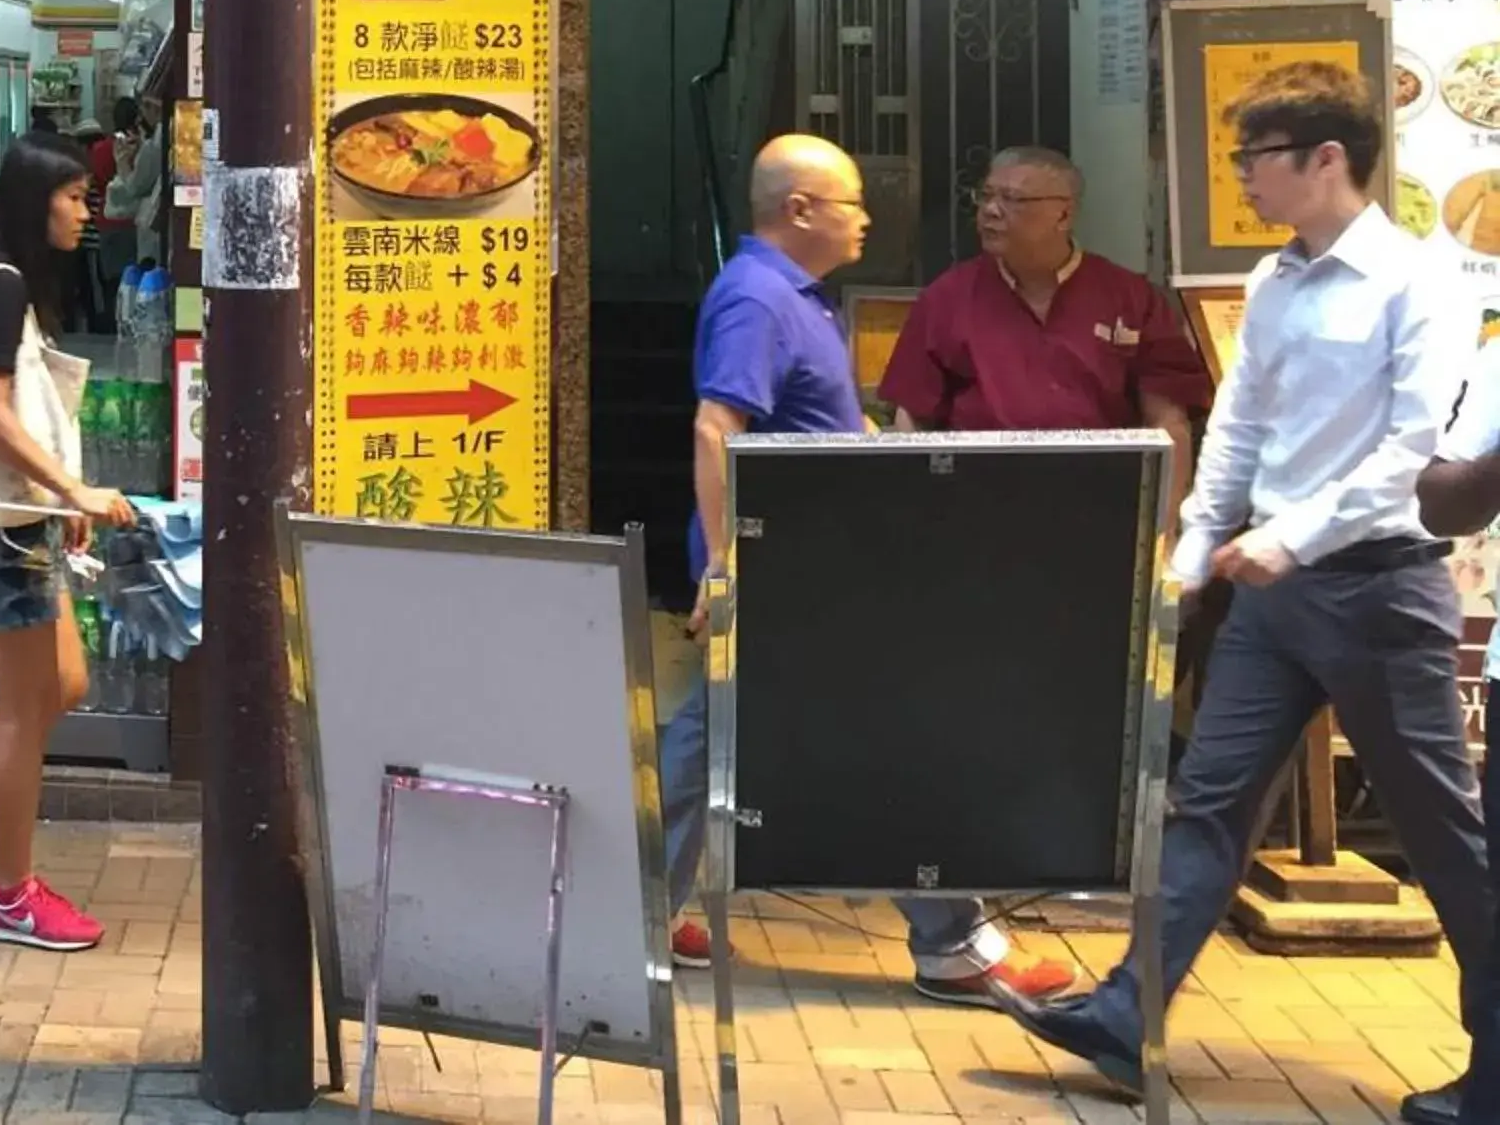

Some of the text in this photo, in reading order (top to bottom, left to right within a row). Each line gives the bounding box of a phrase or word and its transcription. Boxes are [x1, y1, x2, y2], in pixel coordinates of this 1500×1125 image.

[355, 24, 369, 48] 8
[474, 22, 523, 50] $23
[342, 225, 529, 256] 雲南米線 $19
[344, 298, 520, 339] 香辣味濃郁
[362, 430, 506, 462] 請上 1/F
[356, 460, 520, 530] 酸辣
